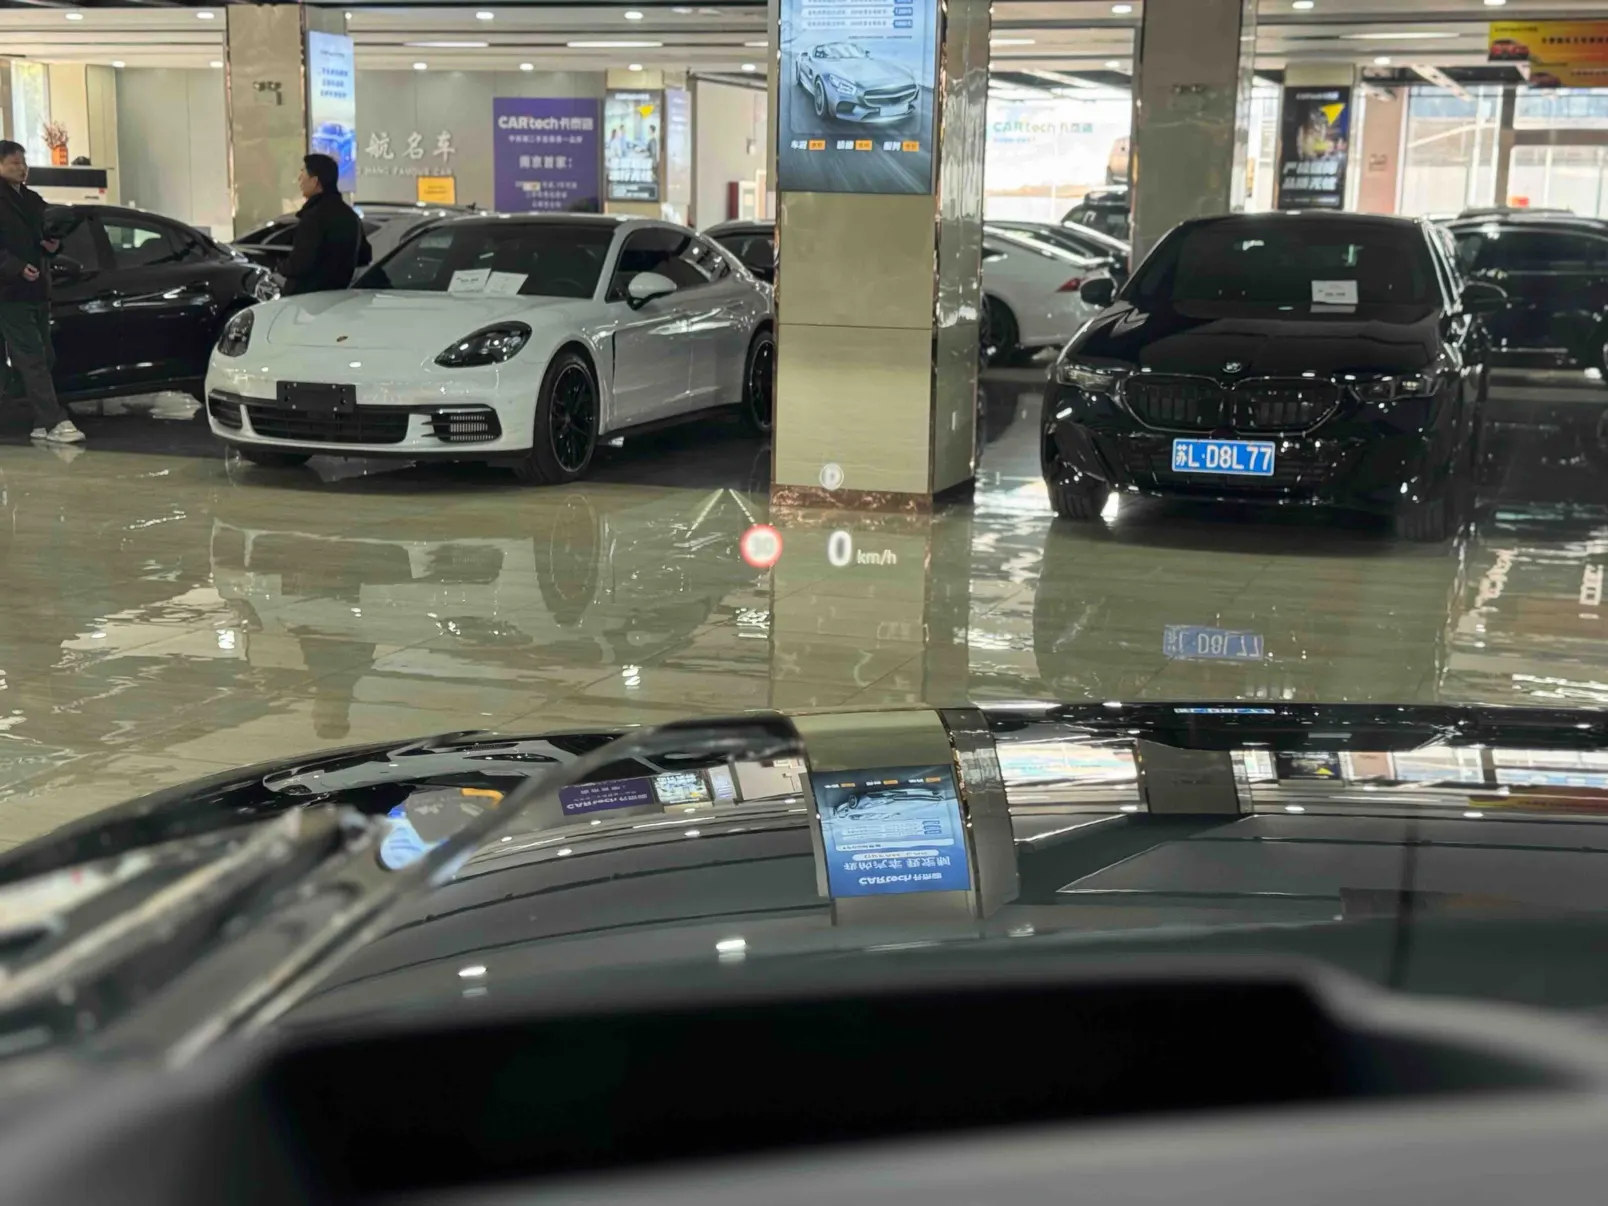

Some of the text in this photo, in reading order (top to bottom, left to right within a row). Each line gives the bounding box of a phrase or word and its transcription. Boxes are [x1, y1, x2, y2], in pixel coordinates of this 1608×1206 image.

[498, 115, 559, 131] CARtech
[828, 530, 897, 567] 0 km/h
